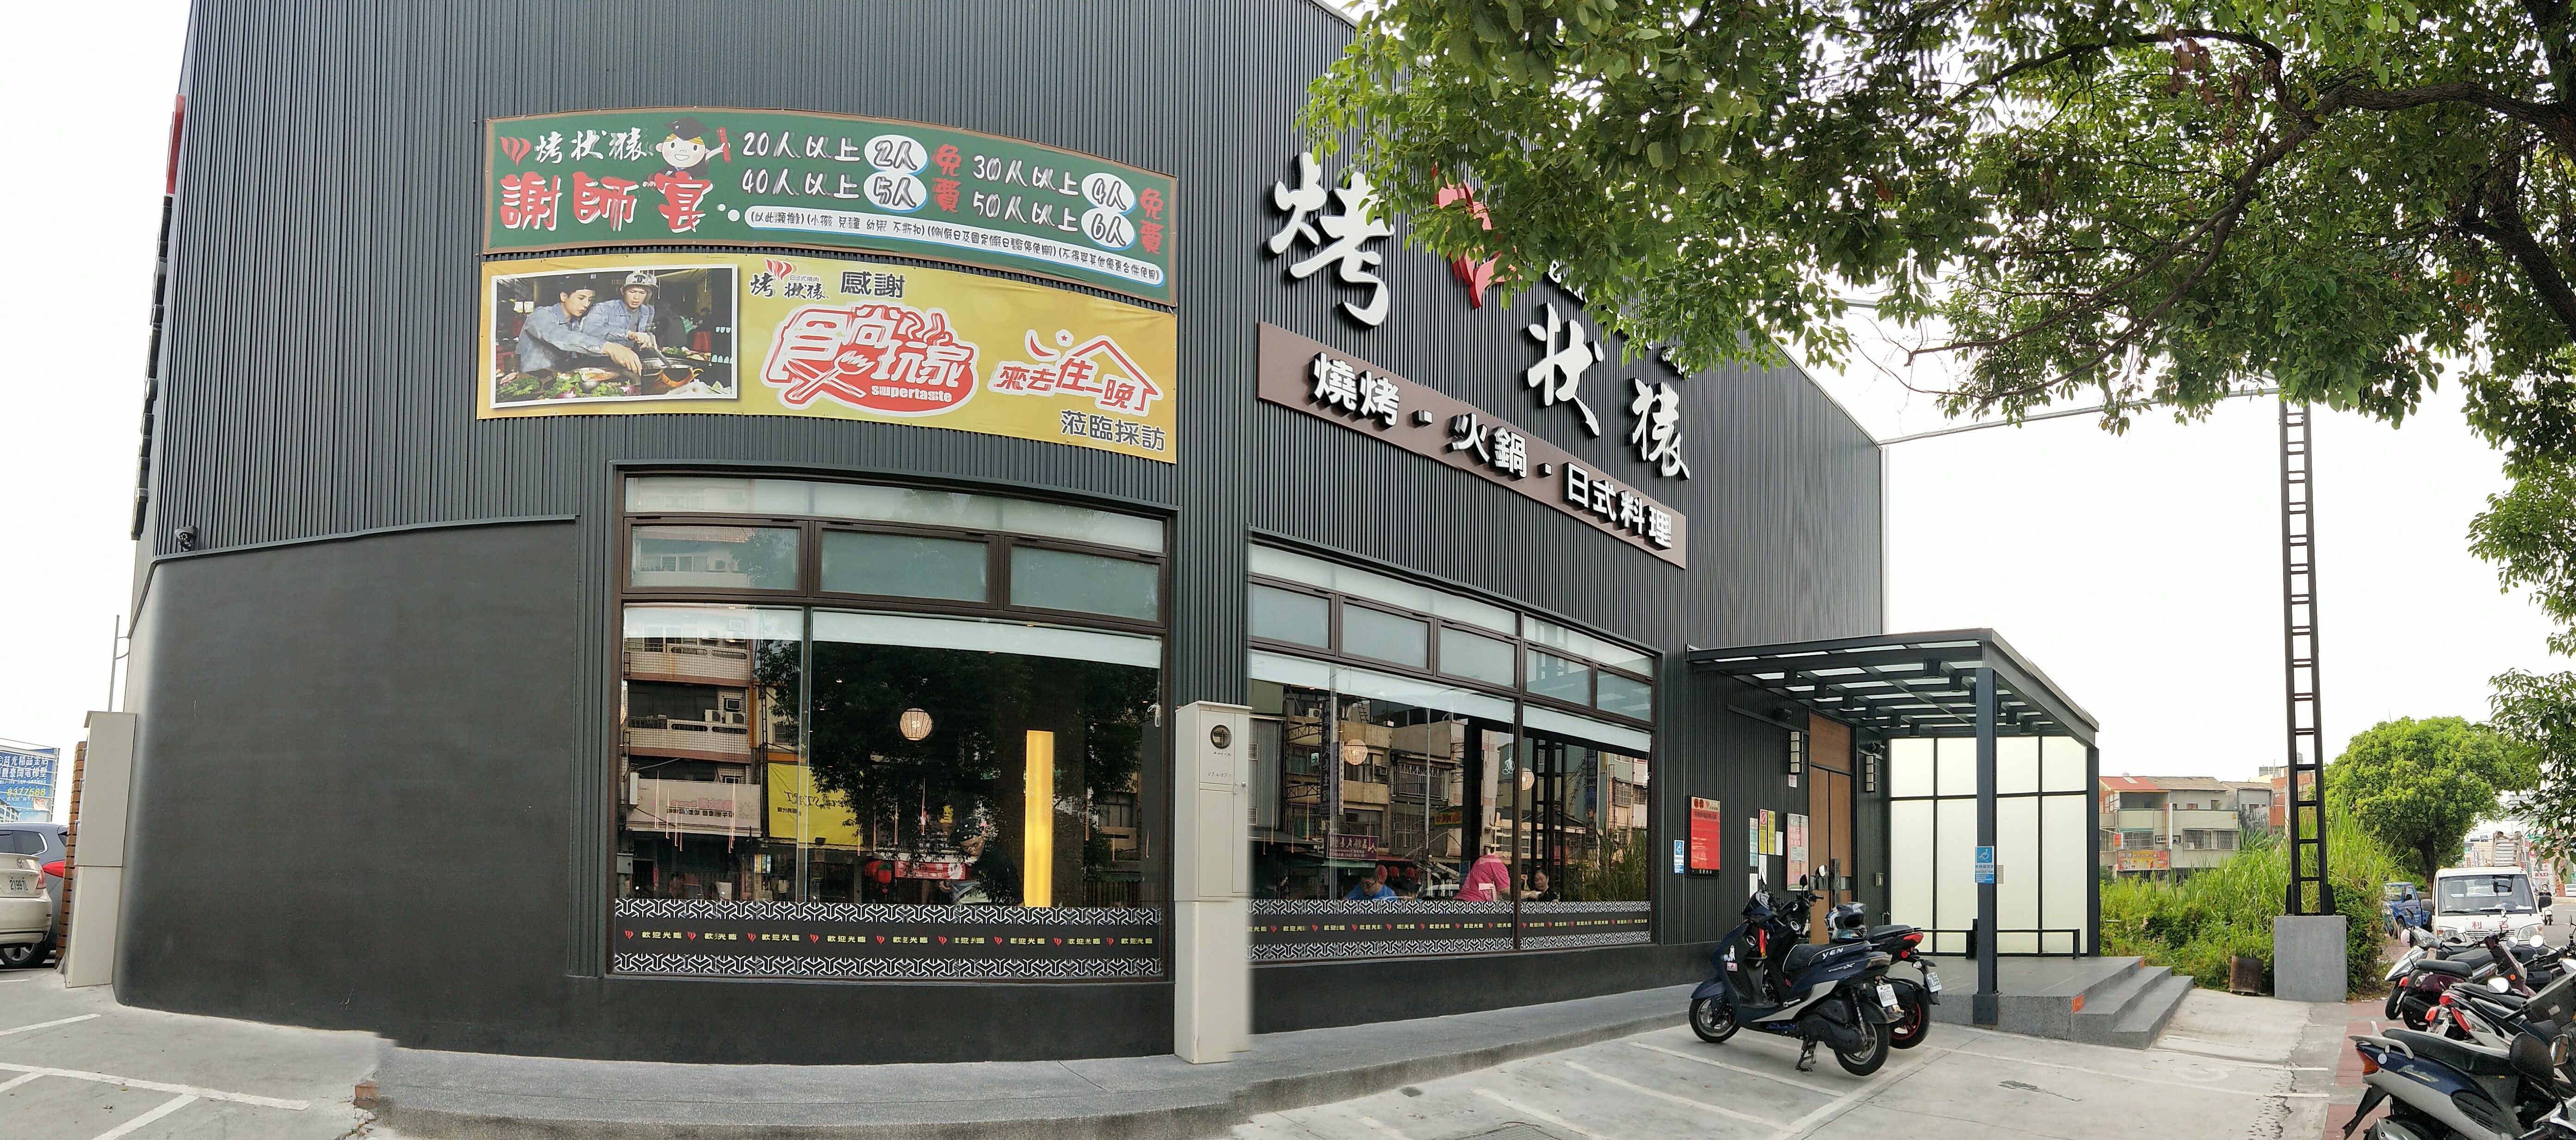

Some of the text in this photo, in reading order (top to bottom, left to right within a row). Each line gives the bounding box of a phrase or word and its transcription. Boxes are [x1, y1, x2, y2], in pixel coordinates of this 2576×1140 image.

[743, 132, 917, 171] 20人以上 2人
[933, 144, 961, 213] 免費
[500, 171, 713, 232] 謝師宴
[743, 168, 917, 208] 40人以上 5人
[973, 155, 1127, 211] 30人以上 4人
[972, 191, 1126, 247] 50人以上 6人
[1140, 188, 1164, 254] 免費
[841, 271, 905, 297] 感謝
[993, 357, 1136, 409] 來去住一晚
[1060, 409, 1165, 451] 蒞臨採訪
[1567, 462, 1672, 549] 日式料理
